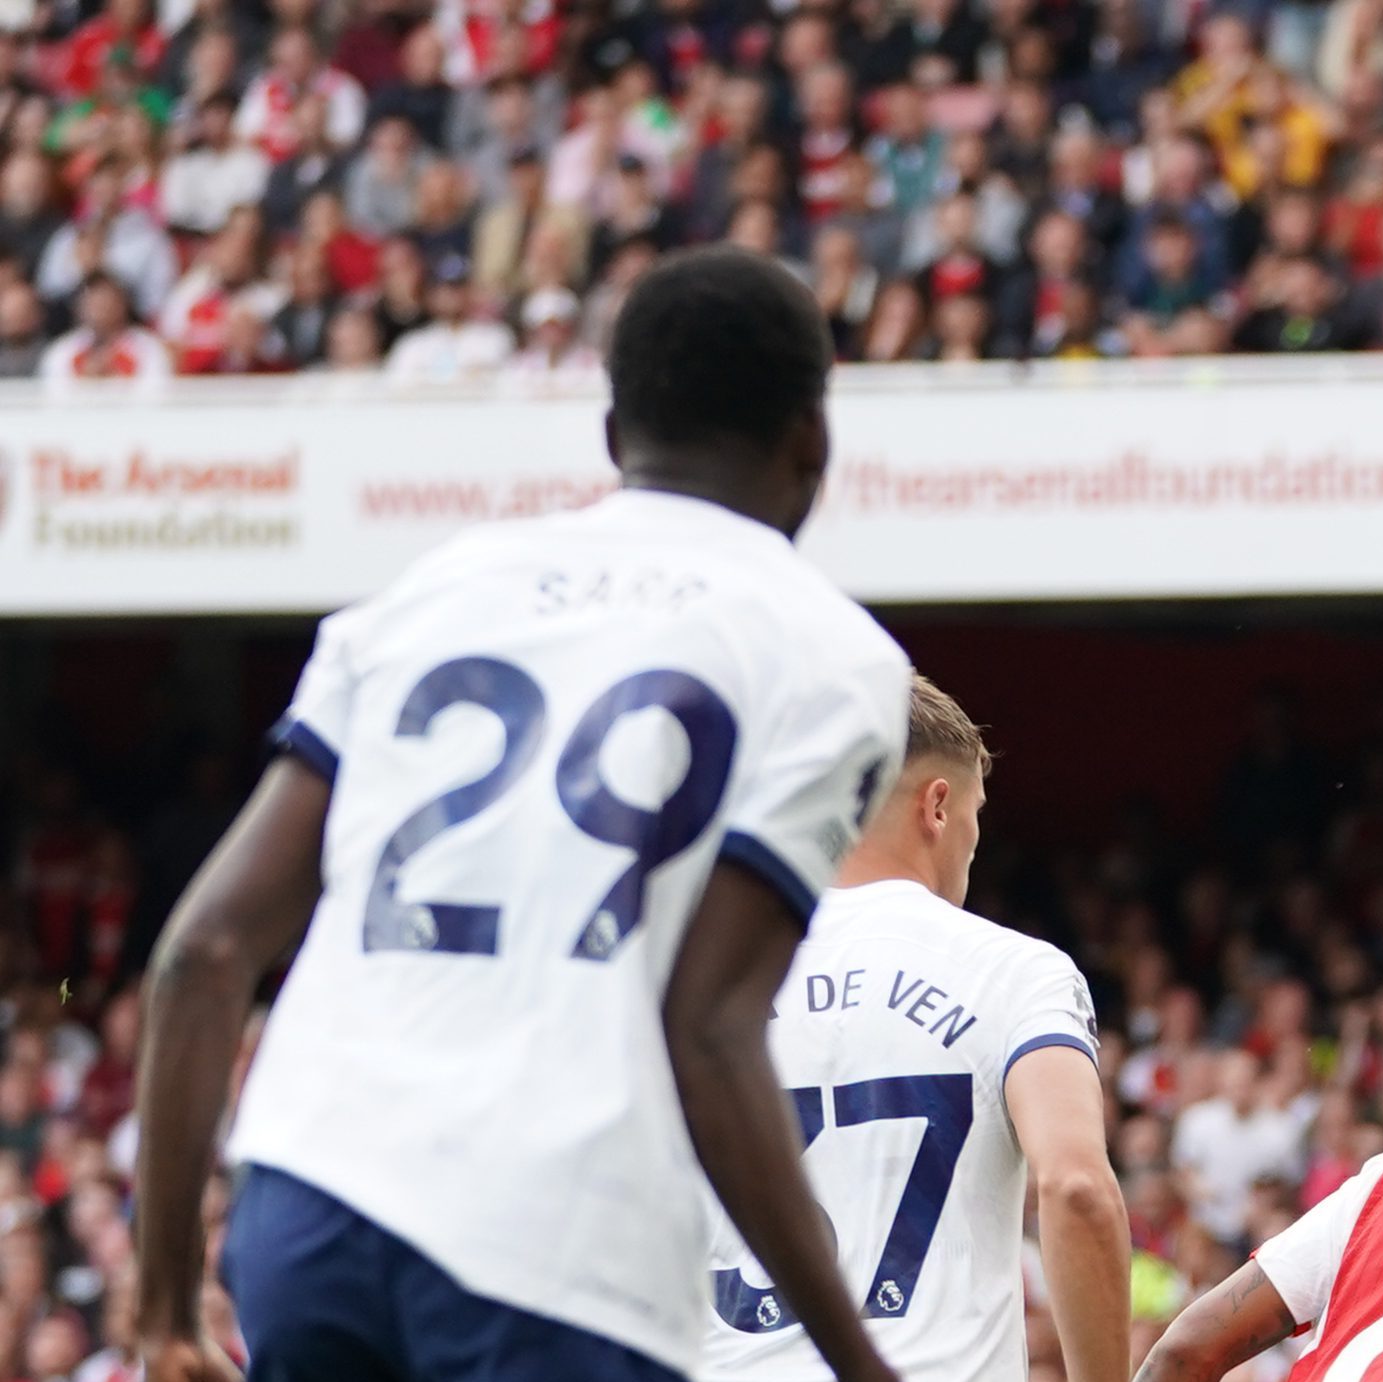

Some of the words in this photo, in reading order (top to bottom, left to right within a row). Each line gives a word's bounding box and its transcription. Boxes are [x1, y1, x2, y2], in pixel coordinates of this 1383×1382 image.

[124, 442, 300, 493] Arsenal
[363, 655, 739, 962] 29
[806, 968, 866, 1013] DE
[887, 969, 977, 1049] VEN
